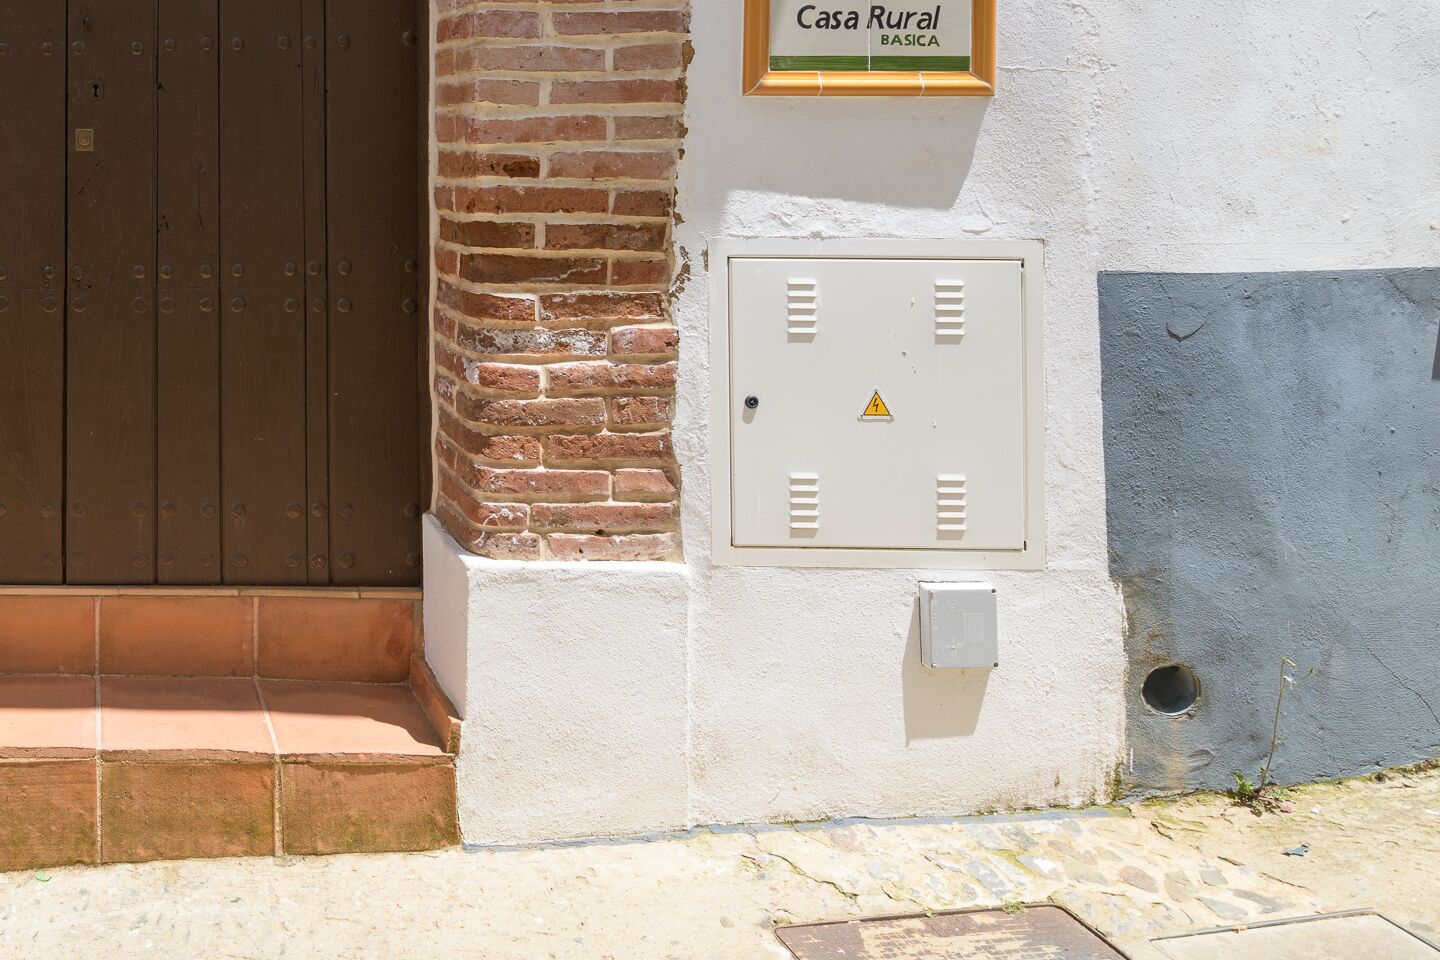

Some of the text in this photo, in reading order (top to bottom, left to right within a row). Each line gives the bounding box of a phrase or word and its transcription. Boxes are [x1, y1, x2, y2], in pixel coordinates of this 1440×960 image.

[796, 5, 941, 30] Casa Rural
[880, 34, 940, 47] BASICA
